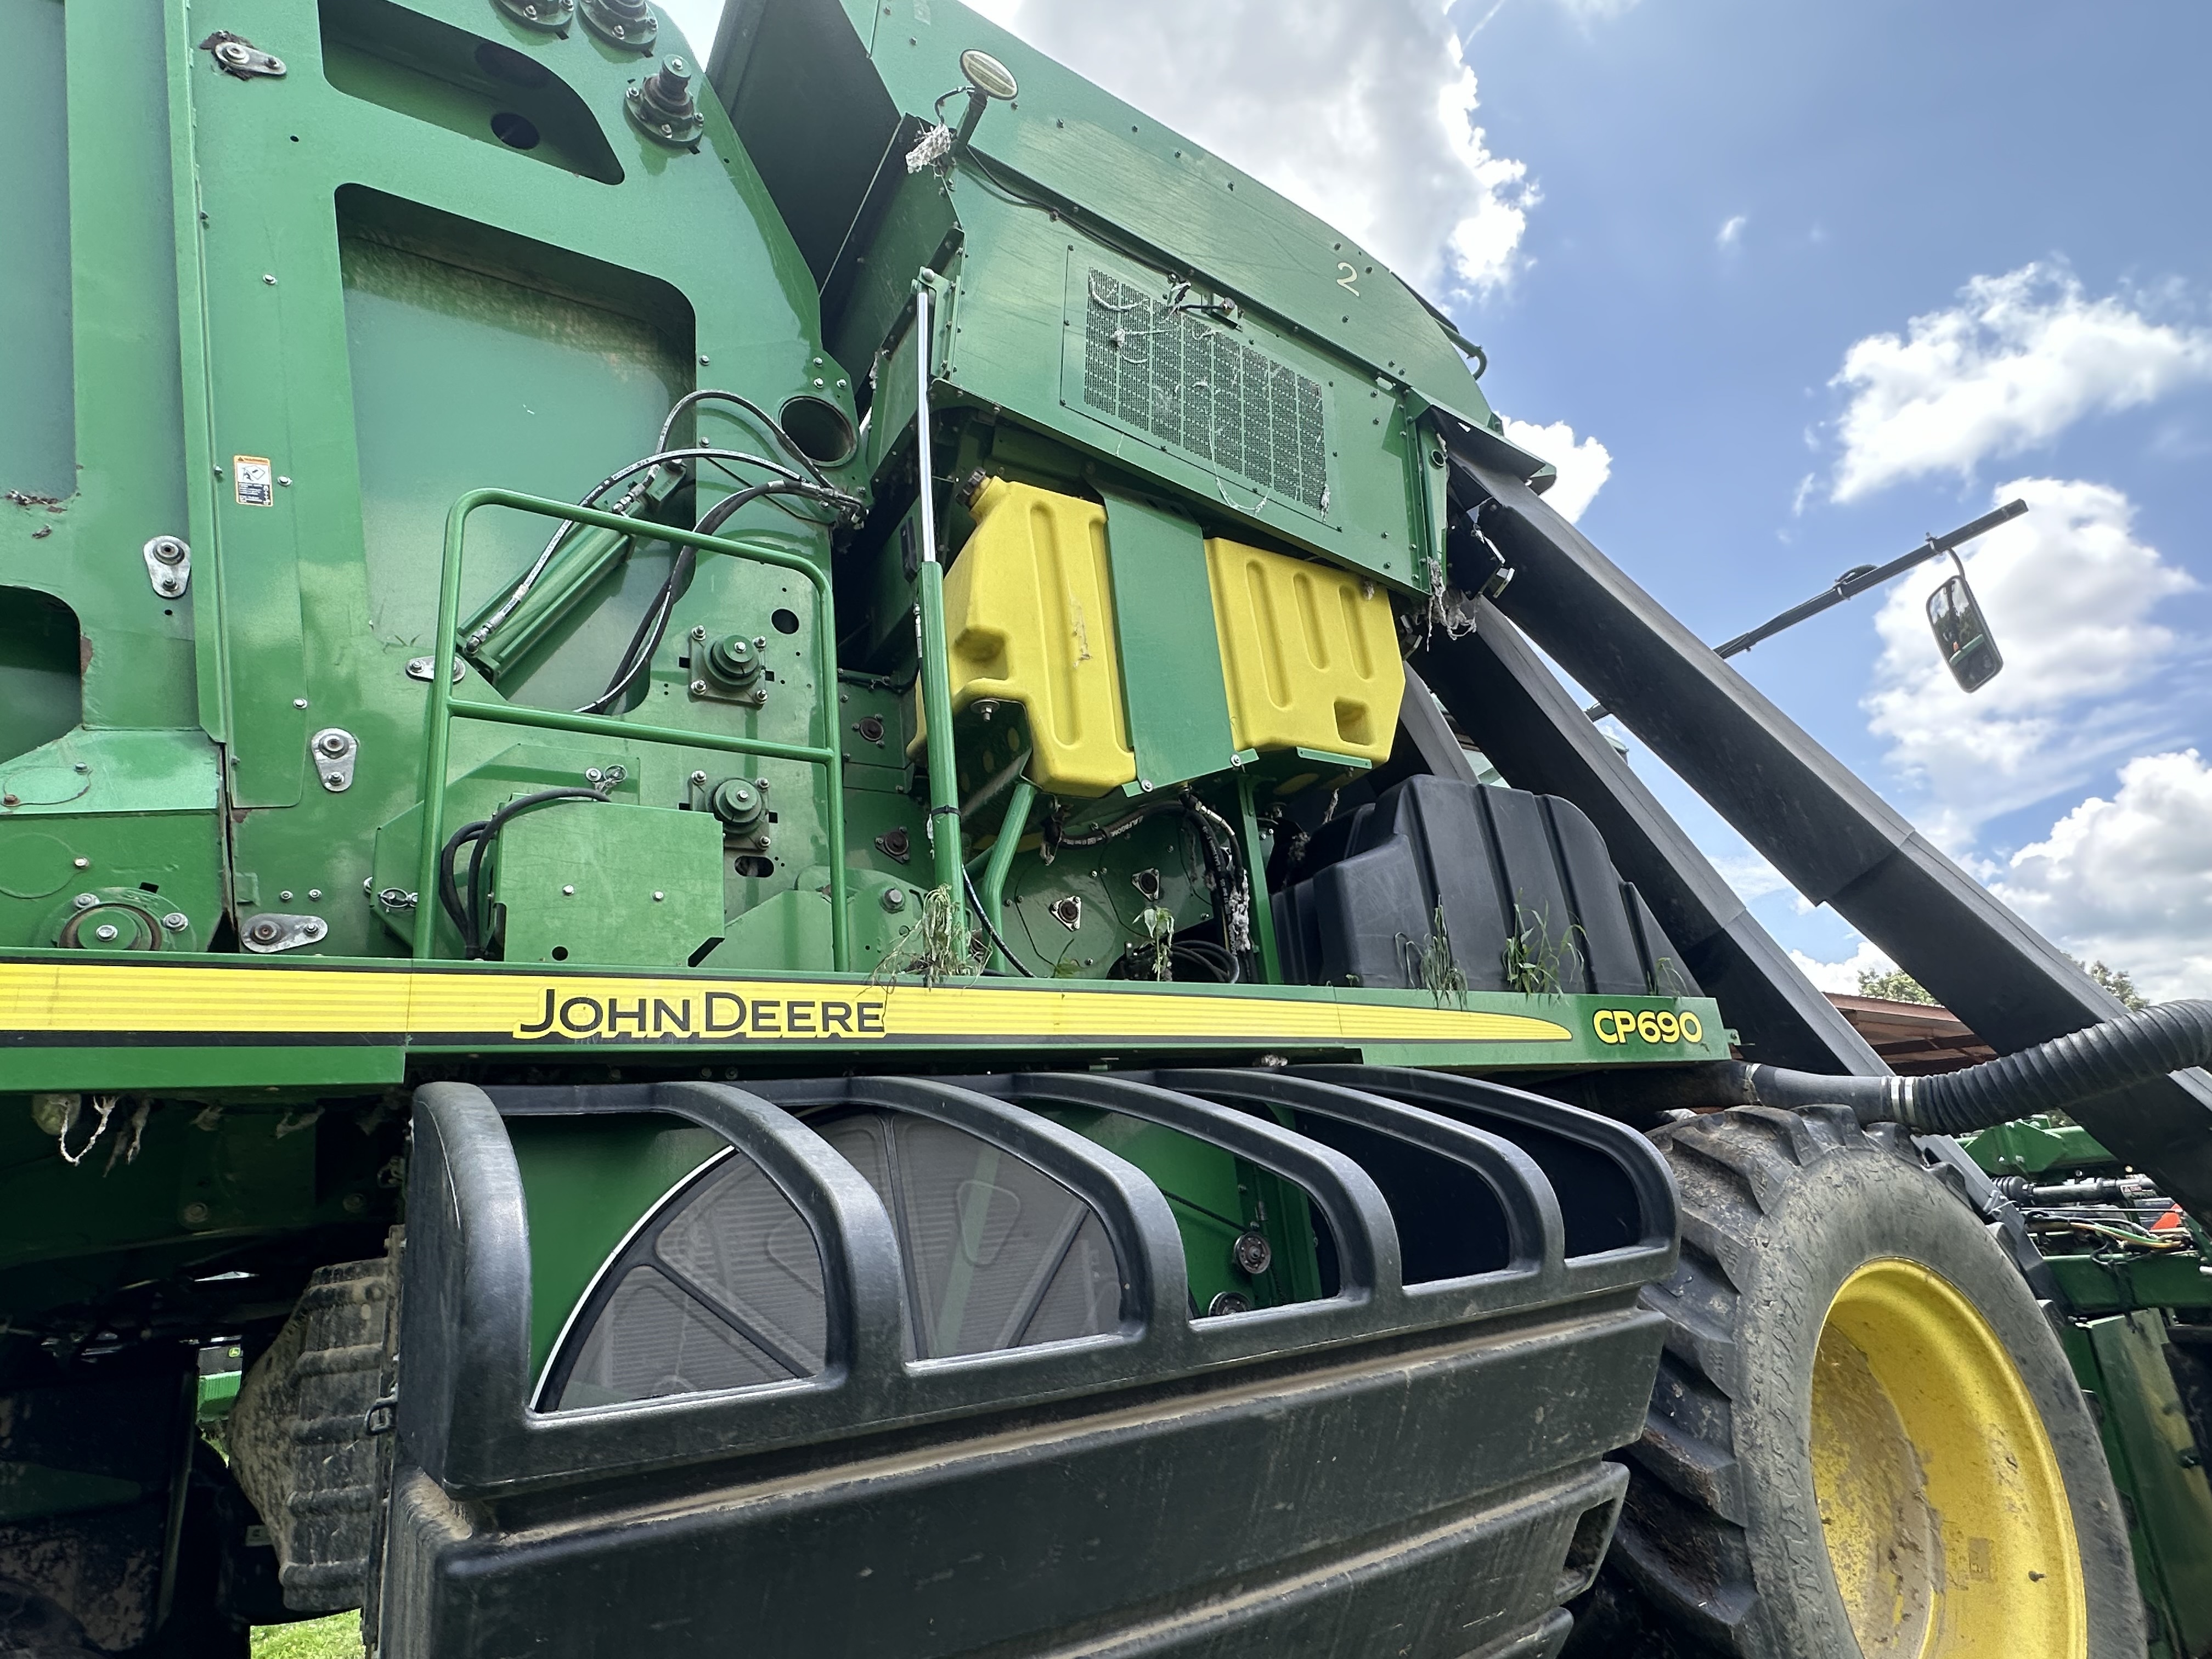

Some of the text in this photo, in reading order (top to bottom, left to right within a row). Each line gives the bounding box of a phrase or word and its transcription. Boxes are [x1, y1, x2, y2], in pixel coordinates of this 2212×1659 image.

[1336, 262, 1360, 297] 2
[520, 988, 885, 1033] JOHN DEERE
[1593, 1009, 1702, 1044] CP690
